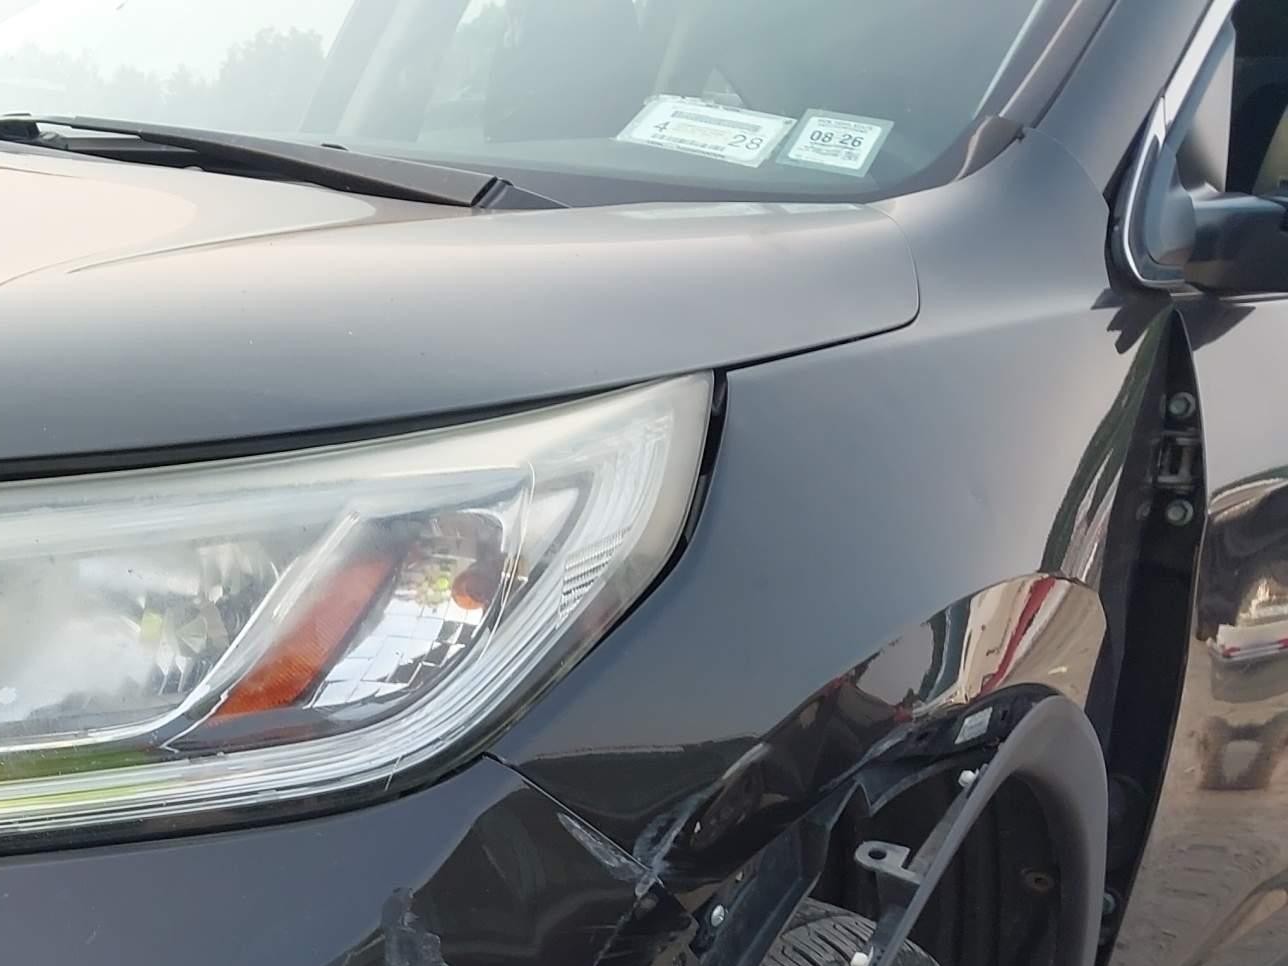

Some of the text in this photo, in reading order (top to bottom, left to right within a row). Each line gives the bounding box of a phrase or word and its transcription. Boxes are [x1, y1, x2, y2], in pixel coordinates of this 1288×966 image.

[653, 121, 670, 133] 4
[727, 133, 764, 151] 28
[809, 129, 865, 148] 08 26
